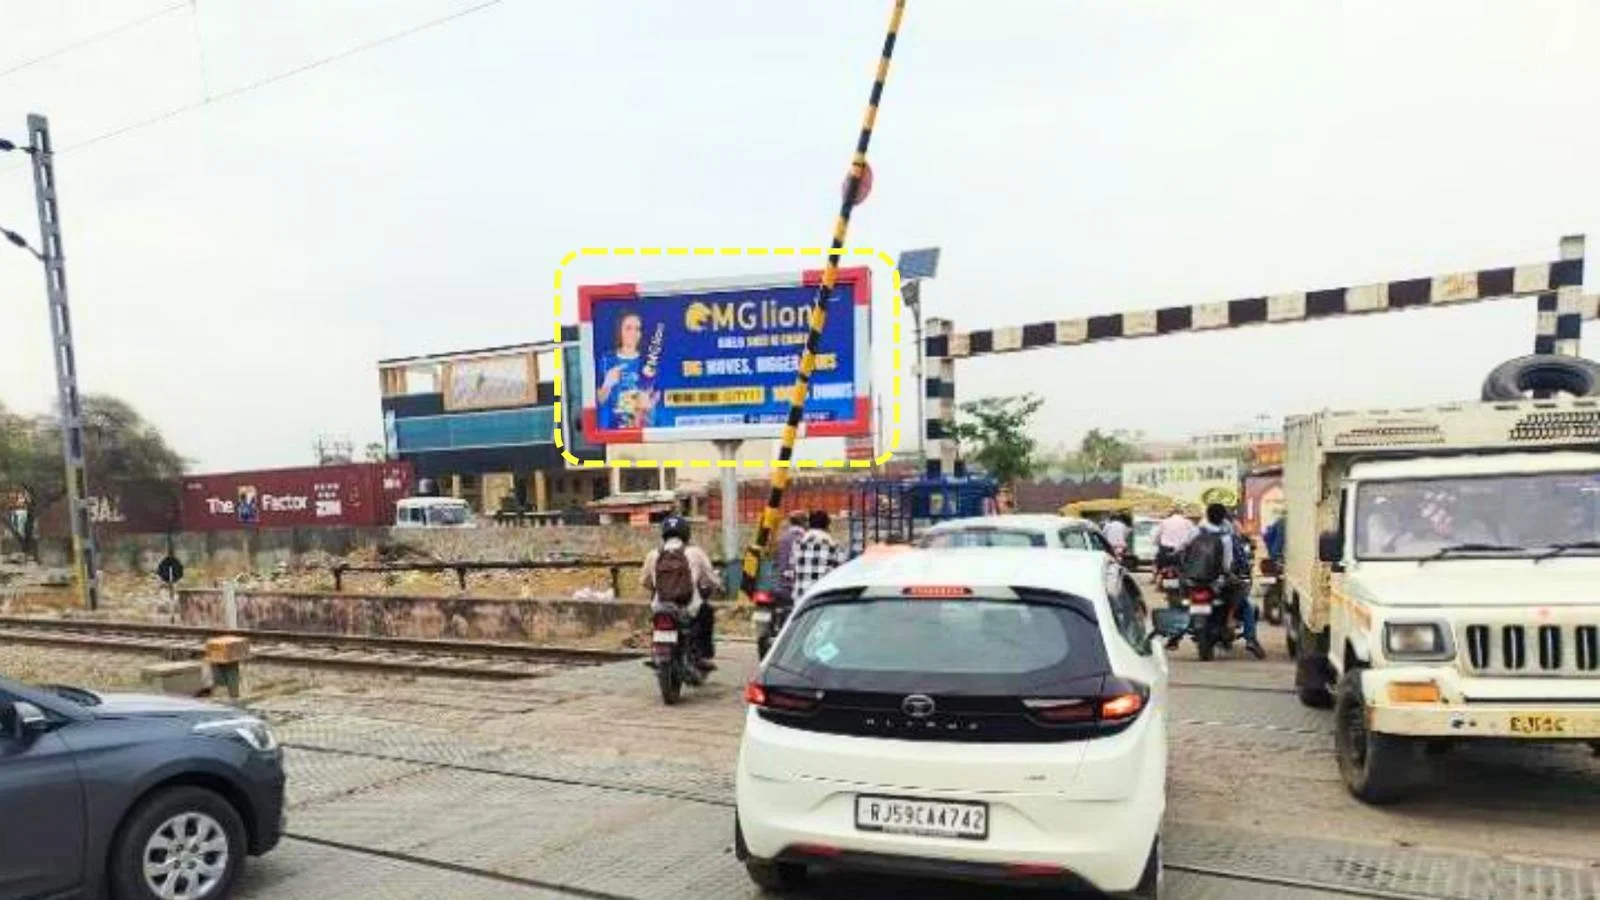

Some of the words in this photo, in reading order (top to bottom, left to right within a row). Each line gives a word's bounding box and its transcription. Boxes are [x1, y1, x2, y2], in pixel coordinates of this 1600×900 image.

[205, 497, 235, 515] The
[261, 493, 308, 511] Factor
[870, 803, 984, 830] RJ59CA4742
